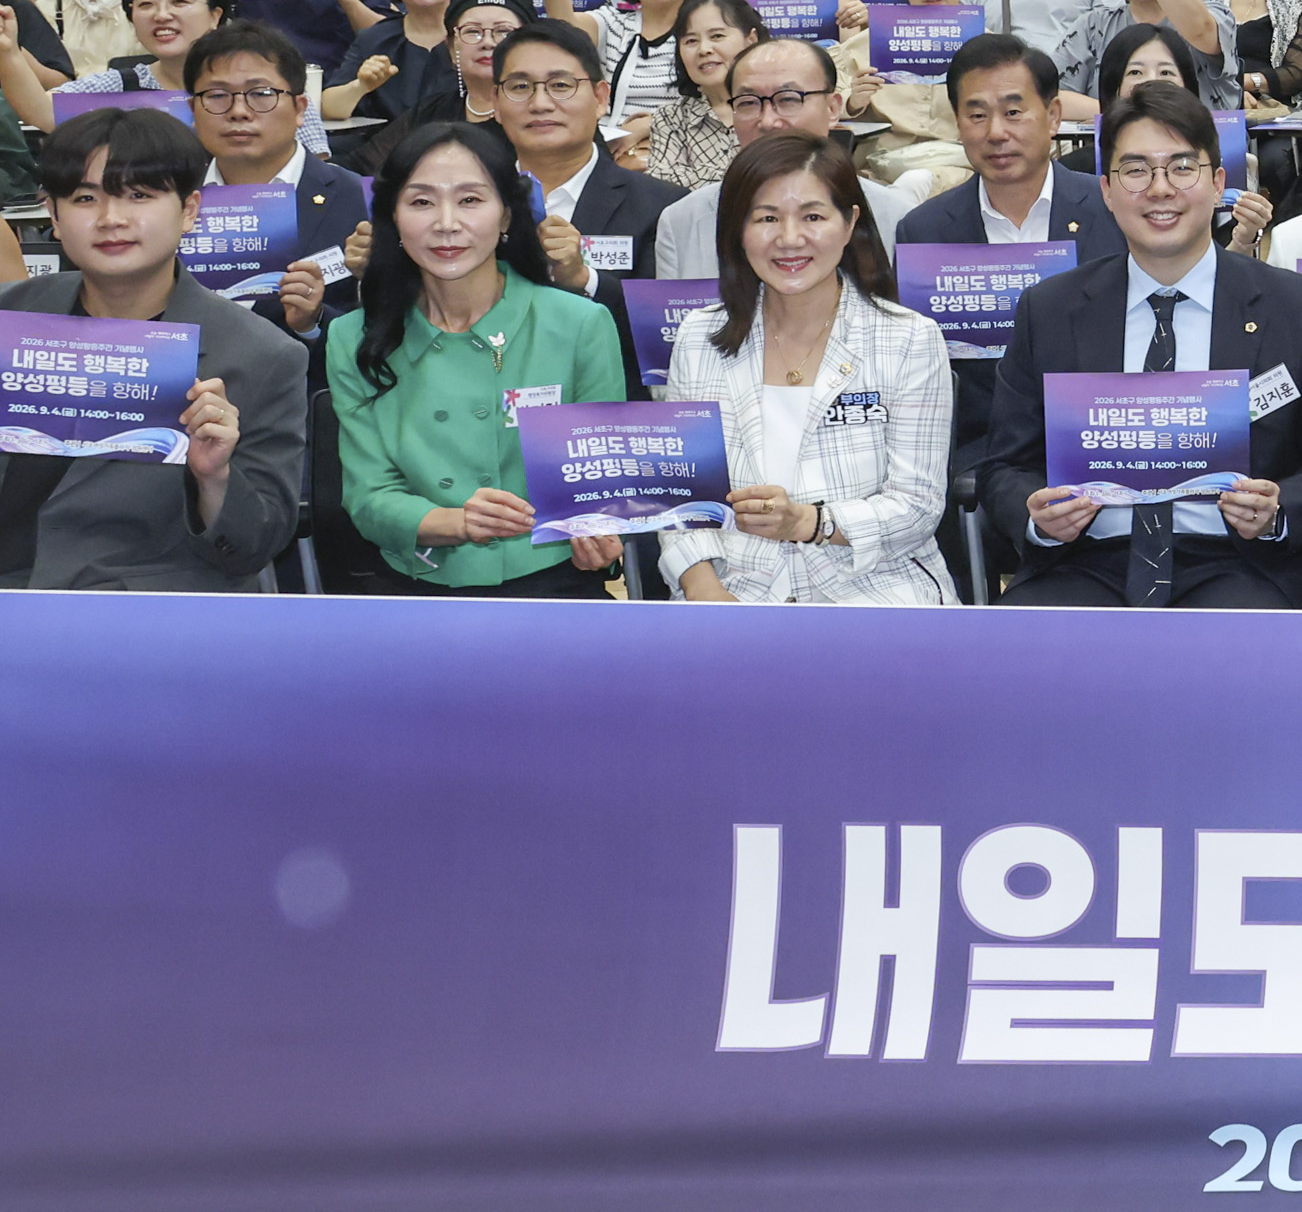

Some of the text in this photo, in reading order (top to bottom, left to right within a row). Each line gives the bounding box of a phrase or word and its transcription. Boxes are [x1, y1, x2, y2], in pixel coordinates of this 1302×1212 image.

[591, 251, 630, 265] 박성준
[321, 261, 346, 277] 지광
[21, 338, 43, 346] 2026
[171, 332, 188, 341] 서초
[12, 348, 149, 377] 내일도 행복한
[1, 371, 158, 401] 양성평등을 향해!
[1224, 379, 1239, 387] 서초
[840, 392, 879, 406] 부의장
[1094, 396, 1114, 404] 2026
[1254, 382, 1294, 410] 김지훈
[8, 404, 38, 414] 2026.
[80, 409, 145, 422] 14:00~16:00
[825, 404, 888, 426] 안종숙
[1089, 407, 1208, 427] 내일도 행복한
[567, 437, 684, 458] 내일도 행복한
[1080, 430, 1217, 449] 양성평등을 향해!
[561, 459, 696, 482] 양성평등을 향해!
[1089, 461, 1115, 470] 2026.
[1150, 461, 1208, 469] 14:00~16:00
